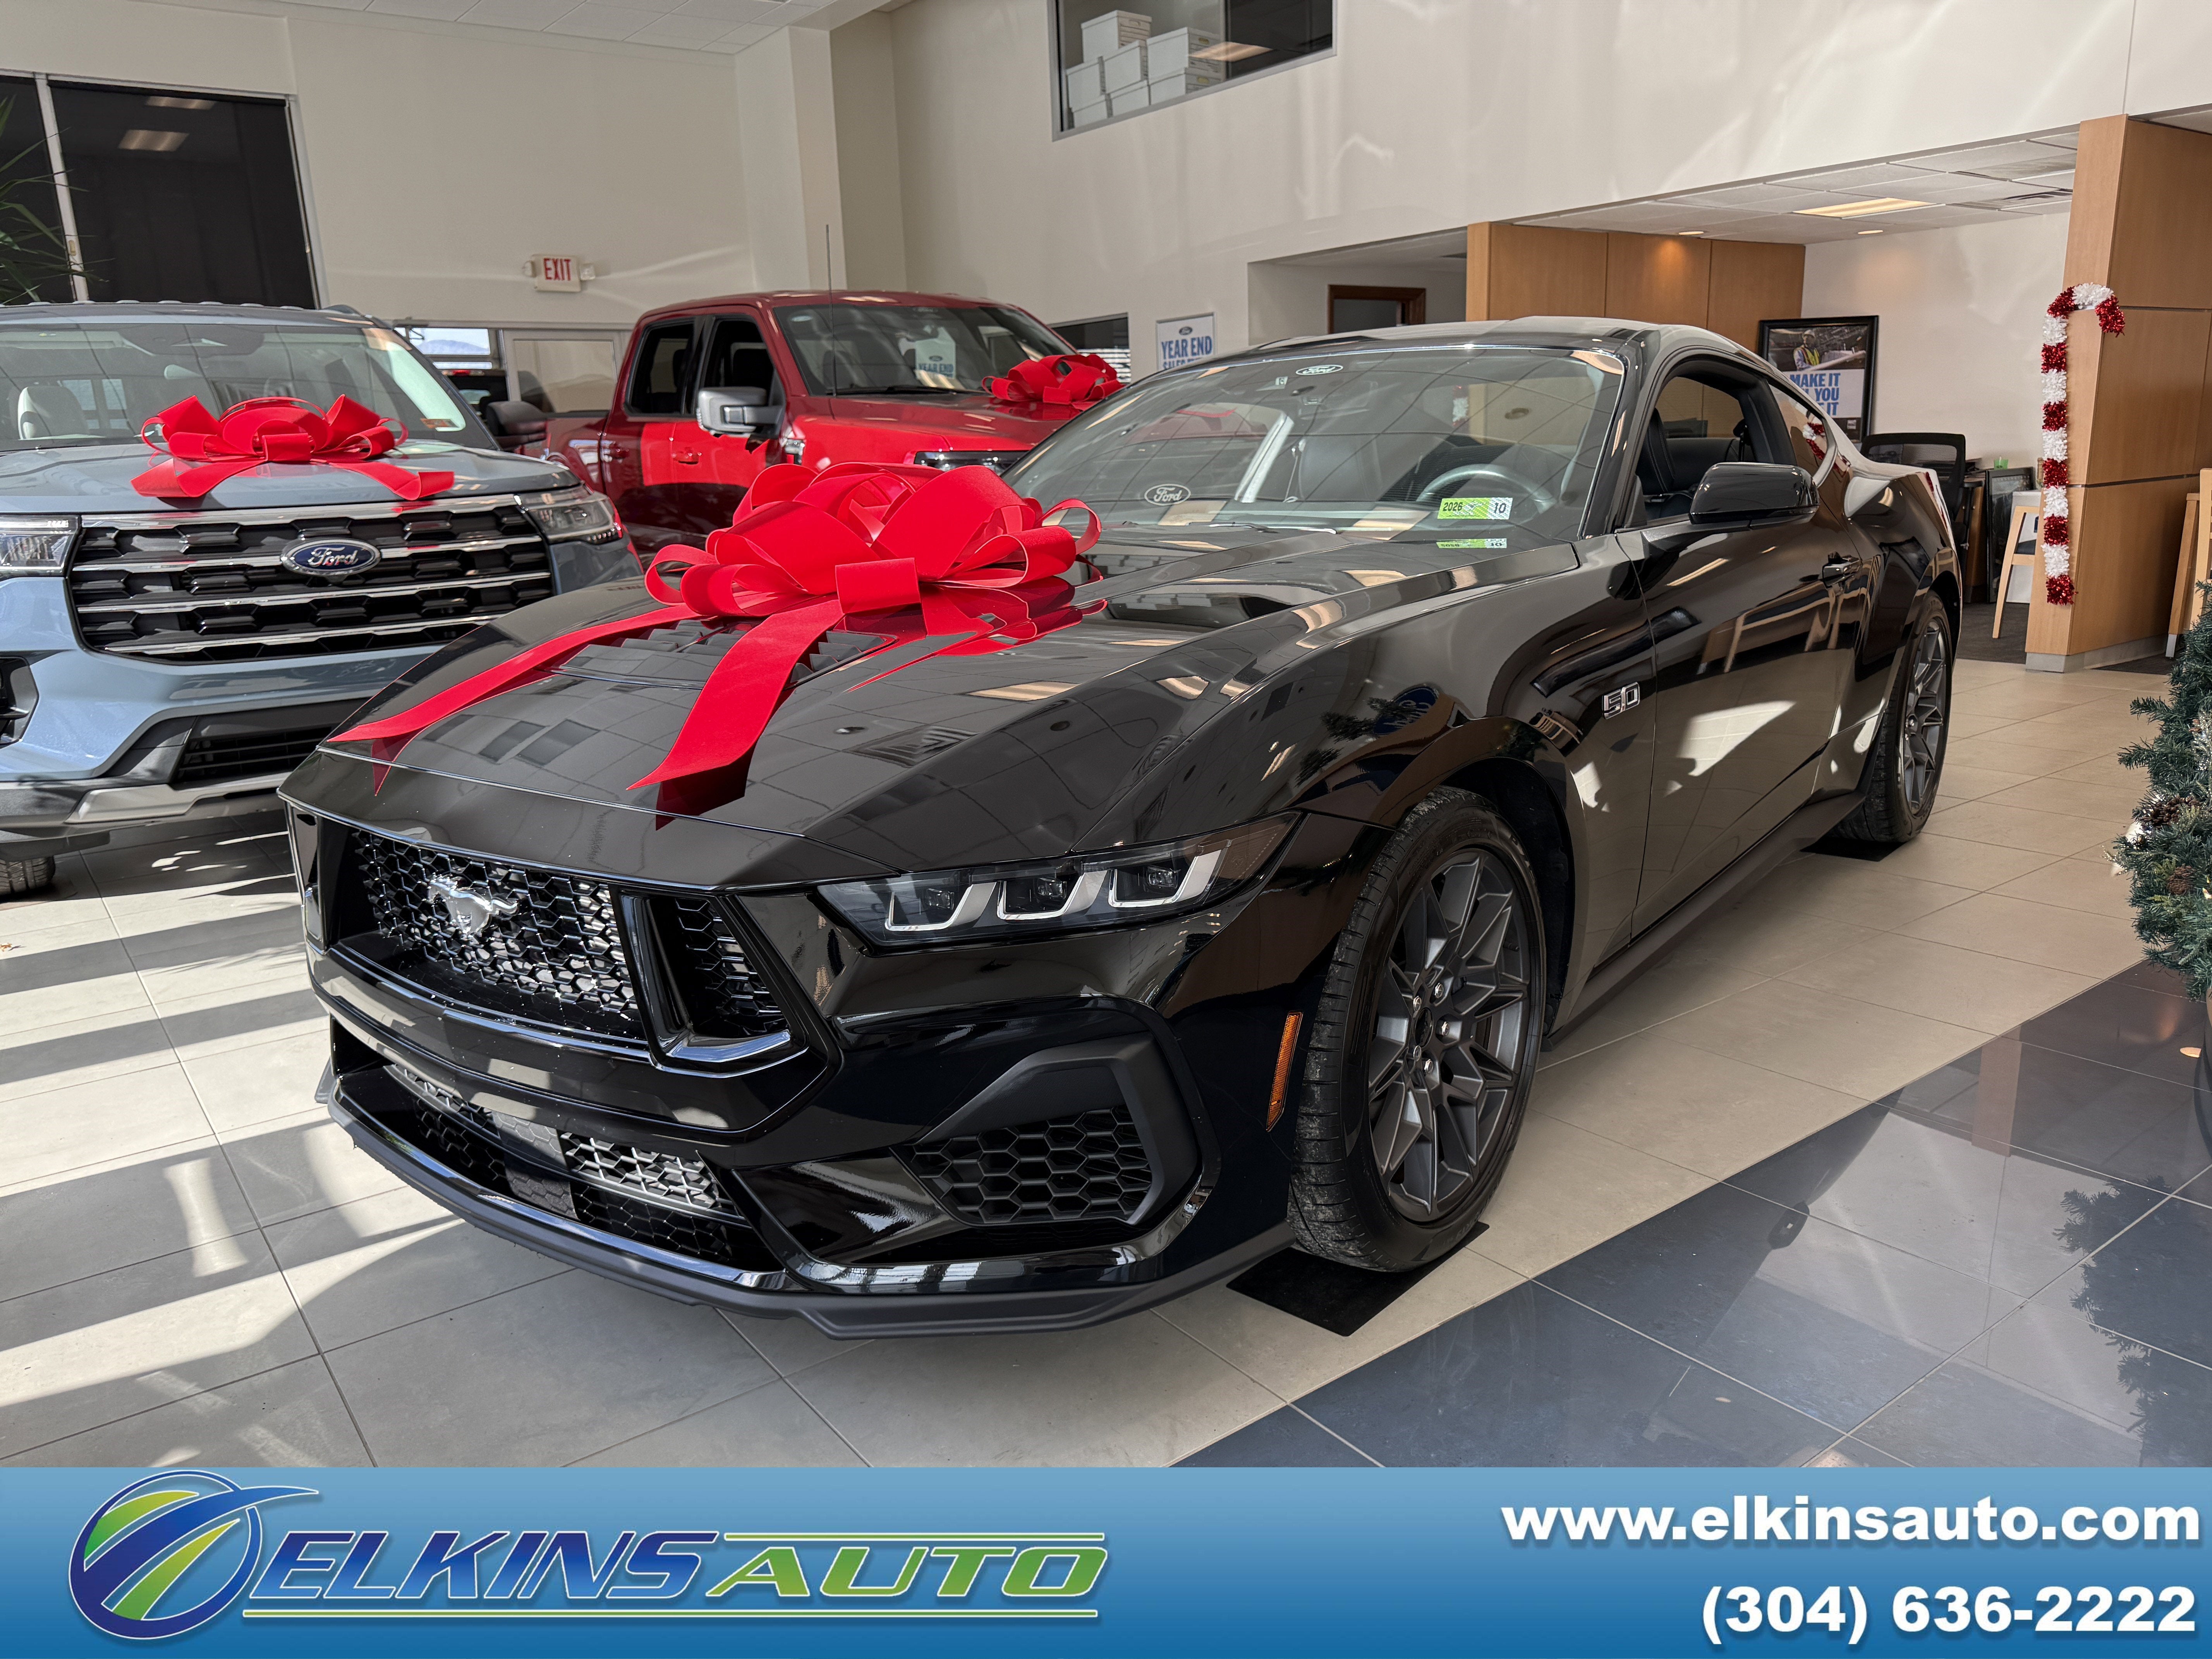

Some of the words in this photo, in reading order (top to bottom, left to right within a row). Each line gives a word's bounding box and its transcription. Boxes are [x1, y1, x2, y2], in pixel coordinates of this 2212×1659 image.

[544, 258, 571, 281] EXIT
[1161, 338, 1188, 360] YEAR
[1190, 335, 1213, 357] END
[1790, 373, 1826, 387] MAKE
[1828, 373, 1841, 387] IT
[1815, 387, 1839, 402] YOU
[1826, 402, 1839, 416] IT
[1153, 487, 1183, 502] Ford
[1442, 501, 1464, 512] 2026
[1494, 502, 1507, 514] 10
[308, 546, 359, 568] Ford
